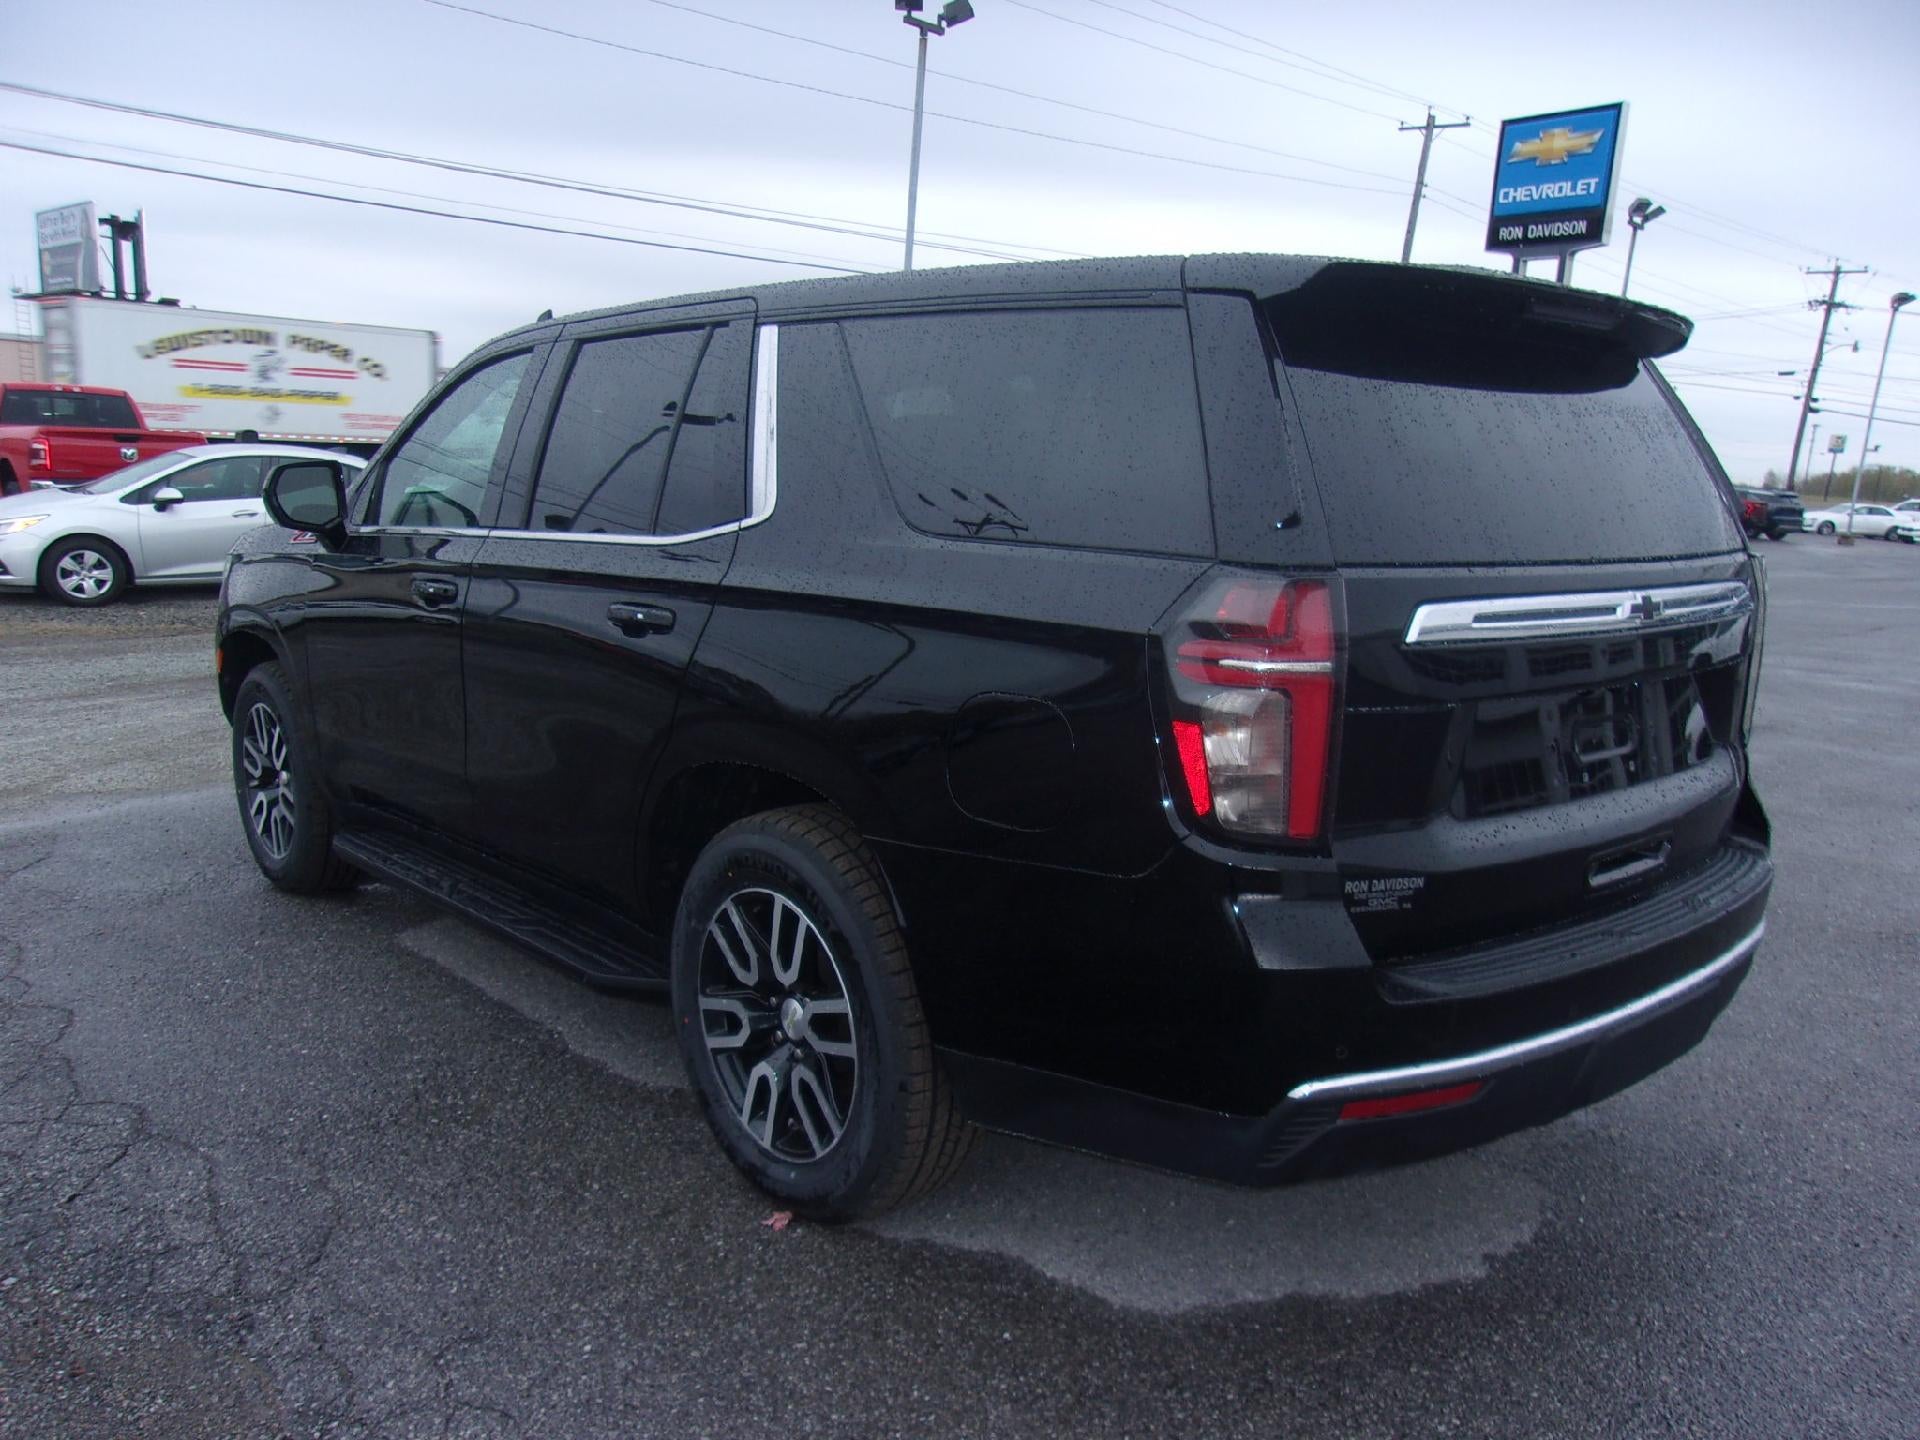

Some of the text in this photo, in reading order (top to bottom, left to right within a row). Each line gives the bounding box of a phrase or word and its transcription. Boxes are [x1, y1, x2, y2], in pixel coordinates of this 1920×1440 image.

[1499, 178, 1598, 203] CHEVROLET
[1499, 221, 1587, 240] RON DAVIDSON
[1344, 877, 1424, 893] RON DAVIDSON
